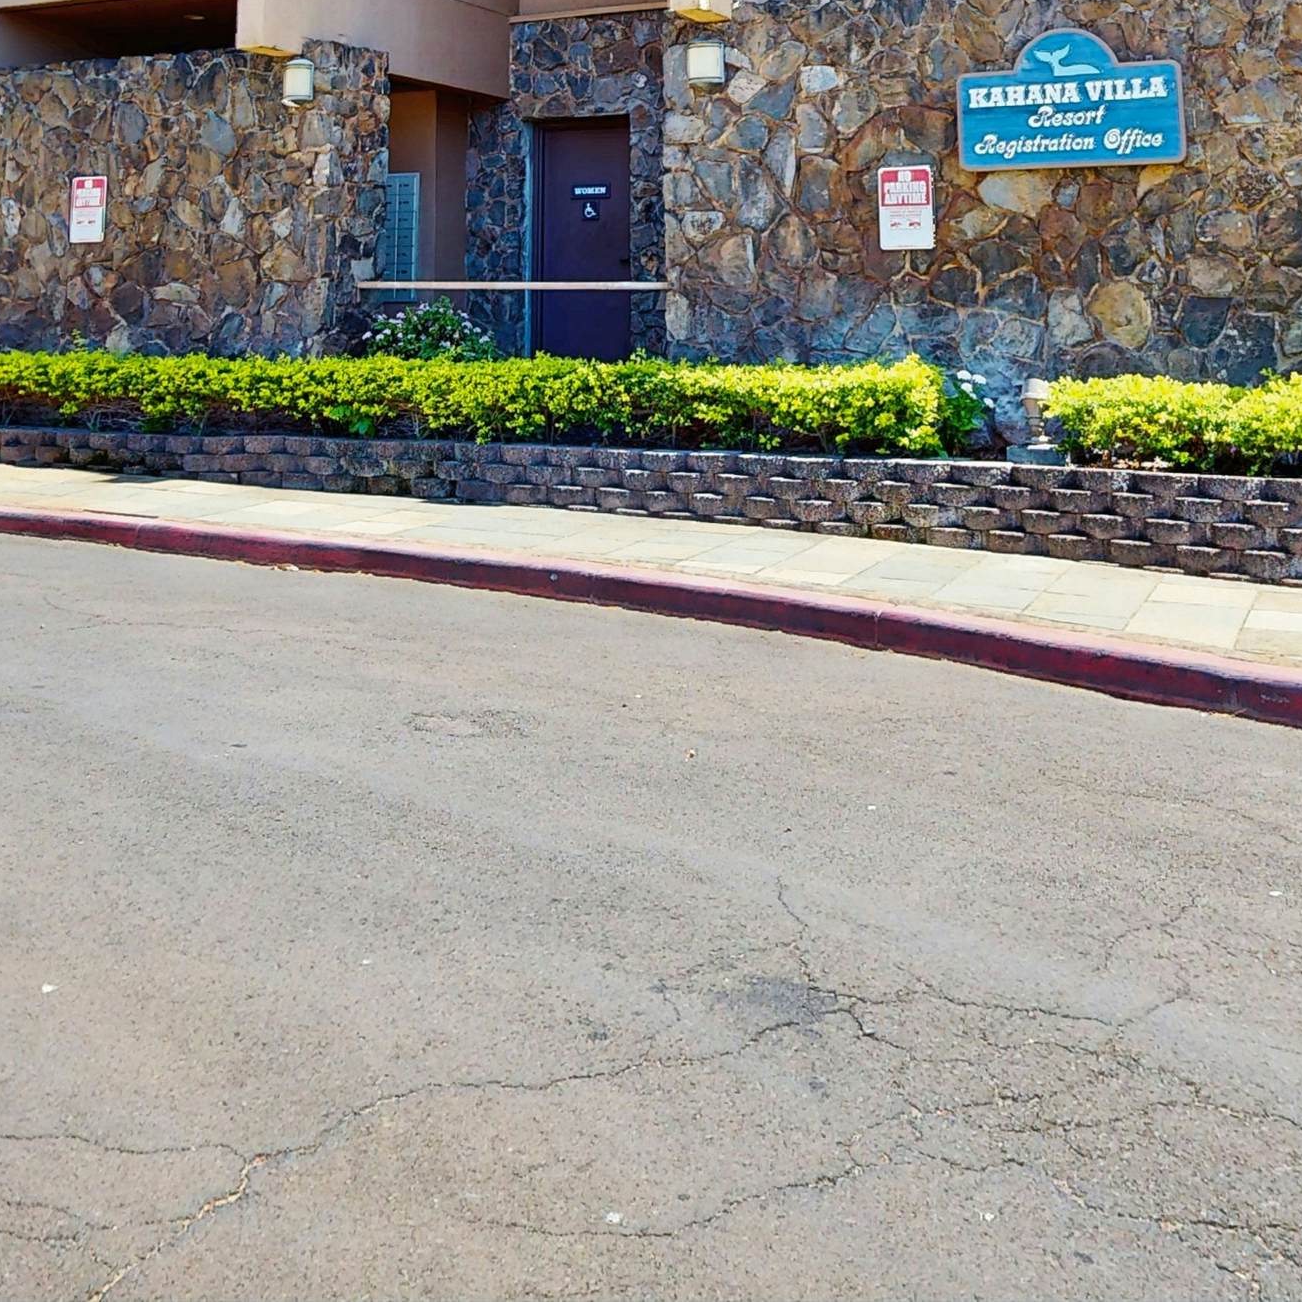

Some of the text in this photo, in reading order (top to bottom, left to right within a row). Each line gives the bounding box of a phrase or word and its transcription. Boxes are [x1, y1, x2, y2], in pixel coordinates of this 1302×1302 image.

[968, 76, 1169, 108] KAHANA VILLA
[1027, 104, 1106, 128] Resort
[974, 128, 1164, 159] Registration Office
[573, 186, 607, 195] WOMEN
